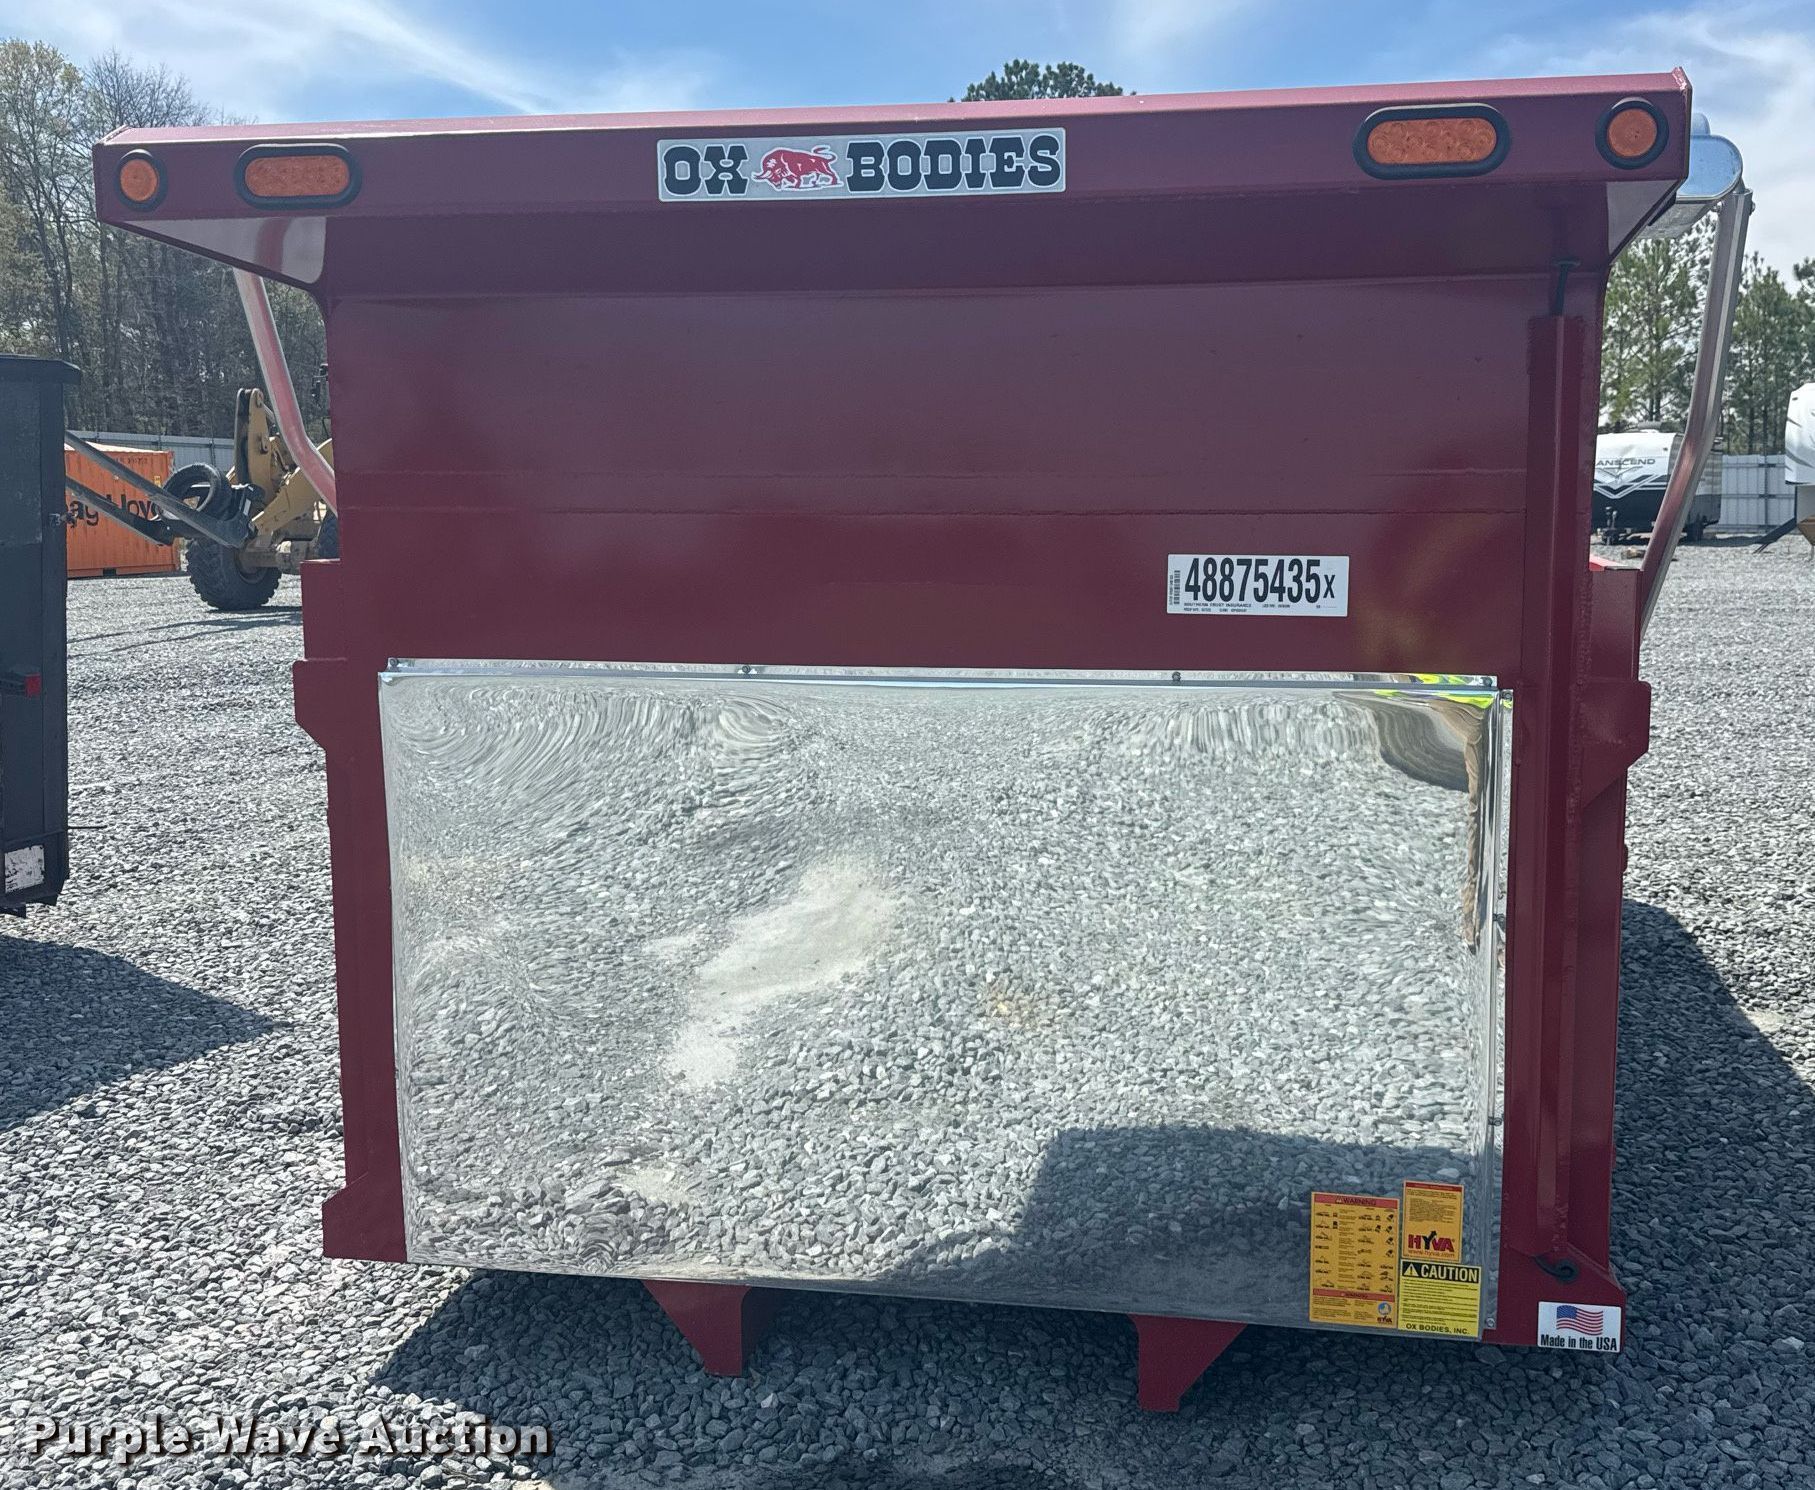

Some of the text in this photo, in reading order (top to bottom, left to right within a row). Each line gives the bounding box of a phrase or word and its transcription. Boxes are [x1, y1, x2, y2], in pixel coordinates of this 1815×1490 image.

[662, 135, 1061, 196] OX BODIES
[1596, 458, 1656, 466] ANSCEND
[1408, 1230, 1454, 1252] HYVA
[1420, 1264, 1478, 1283] CAUTION
[1454, 1327, 1470, 1335] INC.
[1540, 1334, 1617, 1351] Made in the USA
